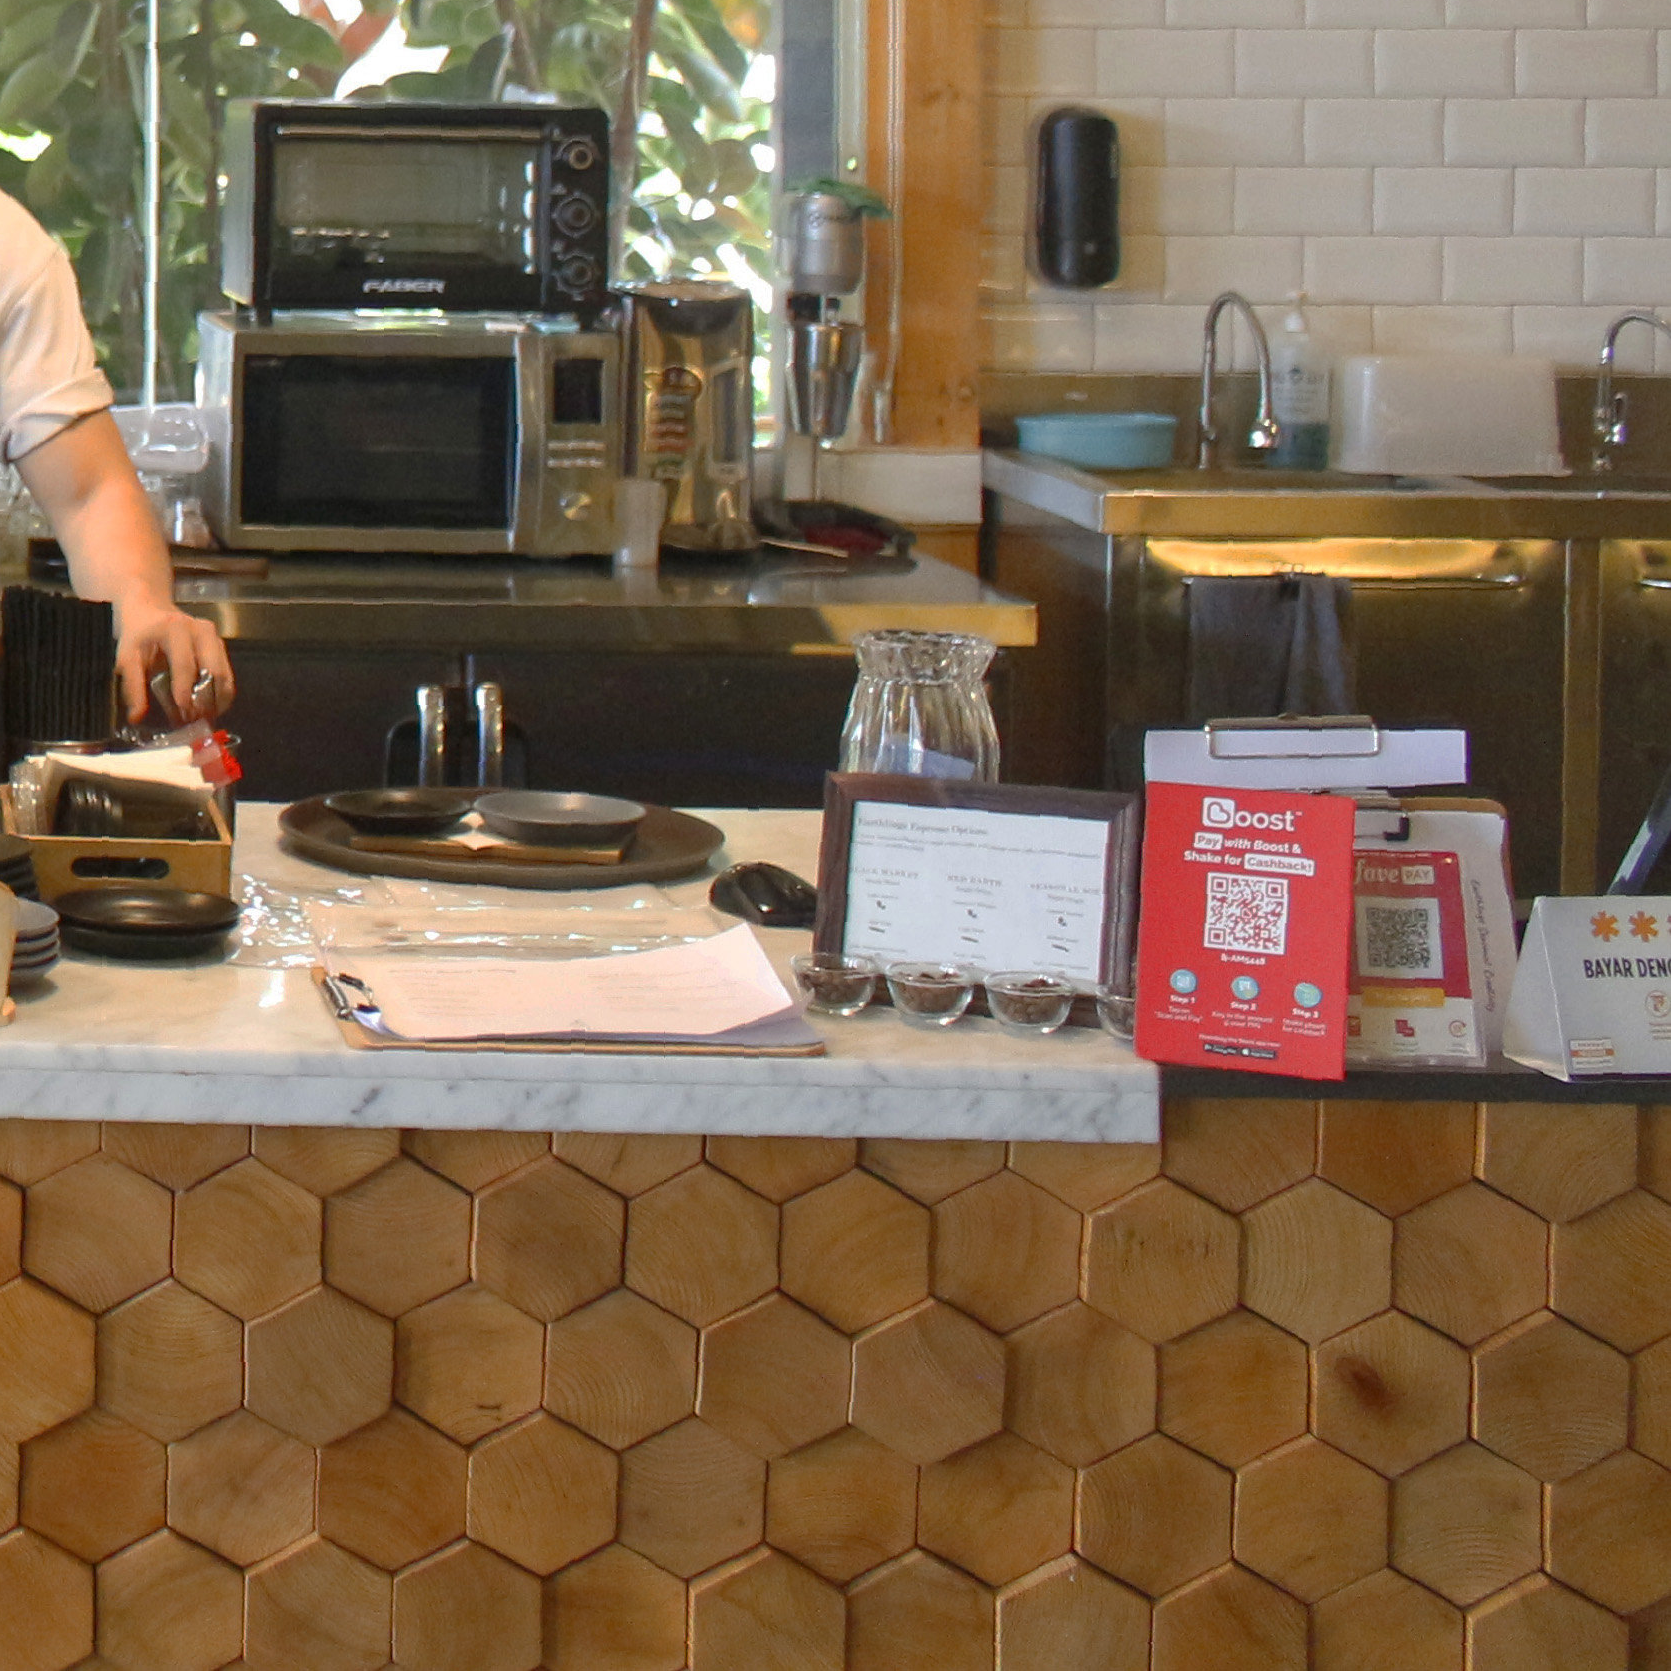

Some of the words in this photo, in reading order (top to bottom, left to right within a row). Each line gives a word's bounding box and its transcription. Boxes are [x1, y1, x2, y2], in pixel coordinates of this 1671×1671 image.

[362, 278, 446, 294] FABER
[1196, 834, 1220, 849] Pay
[1224, 838, 1251, 851] with
[1253, 839, 1290, 854] Boost
[1291, 842, 1303, 855] &
[1183, 849, 1222, 864] Shake
[1224, 852, 1242, 866] for
[1247, 856, 1314, 874] Cashback!
[1355, 858, 1400, 885] fave
[1404, 868, 1431, 881] PAY
[1583, 958, 1634, 979] BAYAR
[1170, 993, 1191, 1006] Step
[1230, 1000, 1252, 1013] Step
